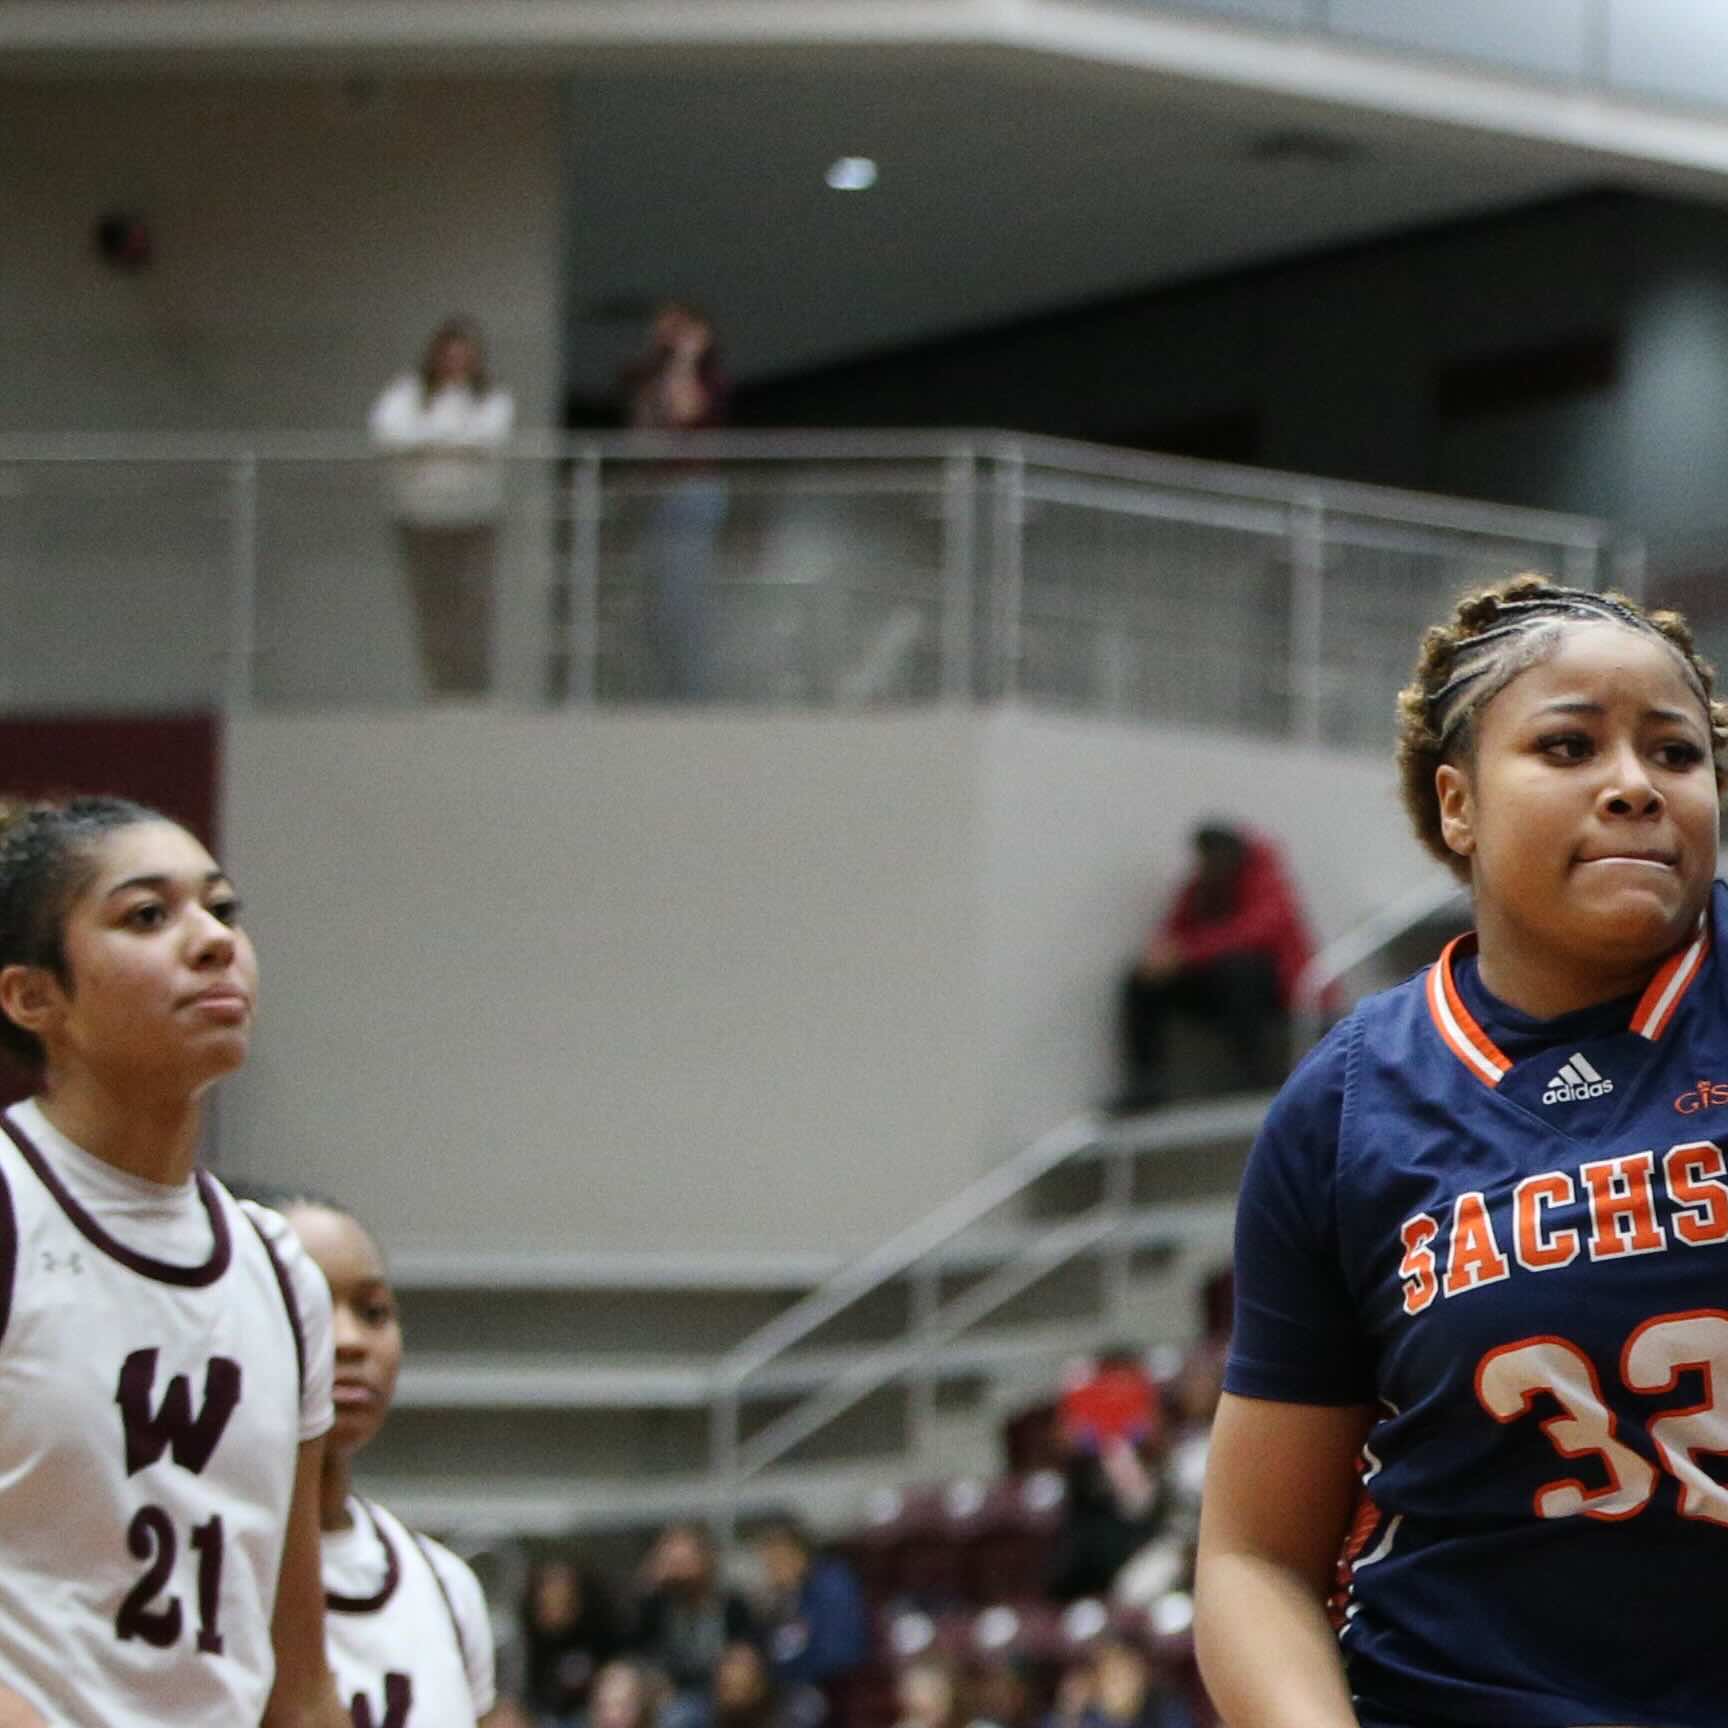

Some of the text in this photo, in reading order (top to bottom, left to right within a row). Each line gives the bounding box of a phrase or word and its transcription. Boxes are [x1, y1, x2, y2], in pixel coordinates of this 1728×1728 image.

[1542, 1079, 1614, 1105] adidas
[115, 1348, 242, 1478] W
[115, 1505, 224, 1654] 21
